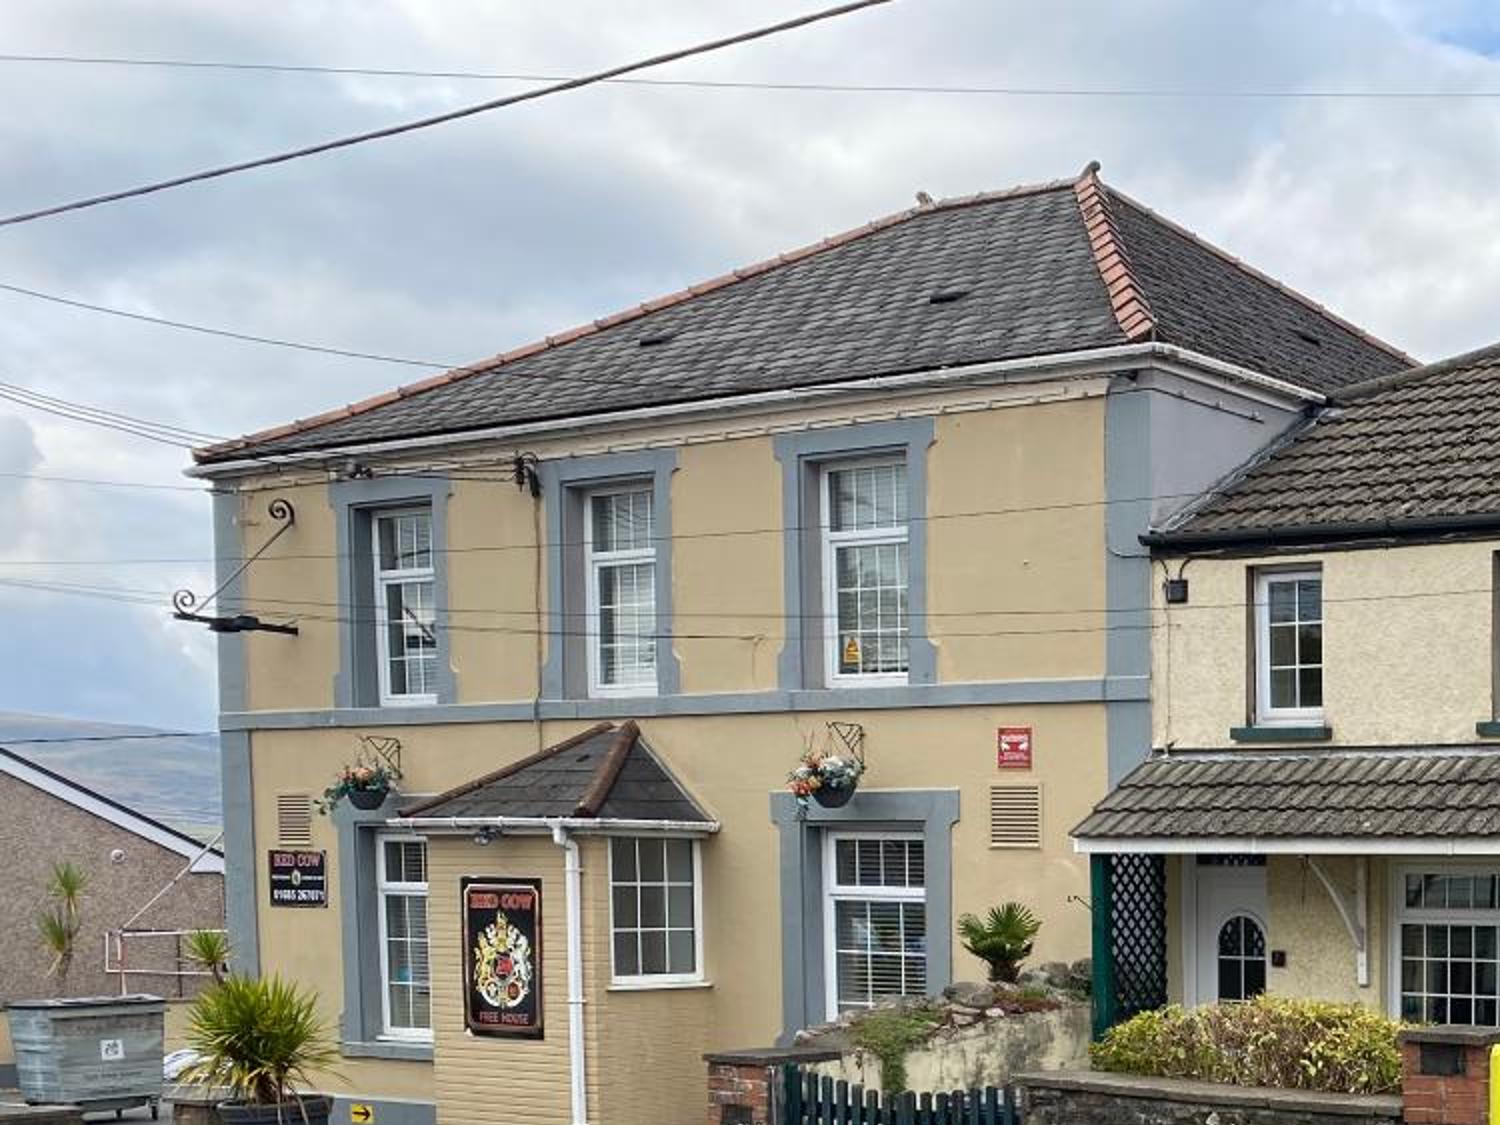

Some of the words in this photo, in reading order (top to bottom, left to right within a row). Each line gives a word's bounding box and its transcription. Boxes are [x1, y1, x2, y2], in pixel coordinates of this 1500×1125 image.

[297, 853, 320, 867] COW
[501, 893, 533, 910] COW
[479, 1011, 499, 1023] FREE
[501, 1012, 529, 1024] HOUSE
